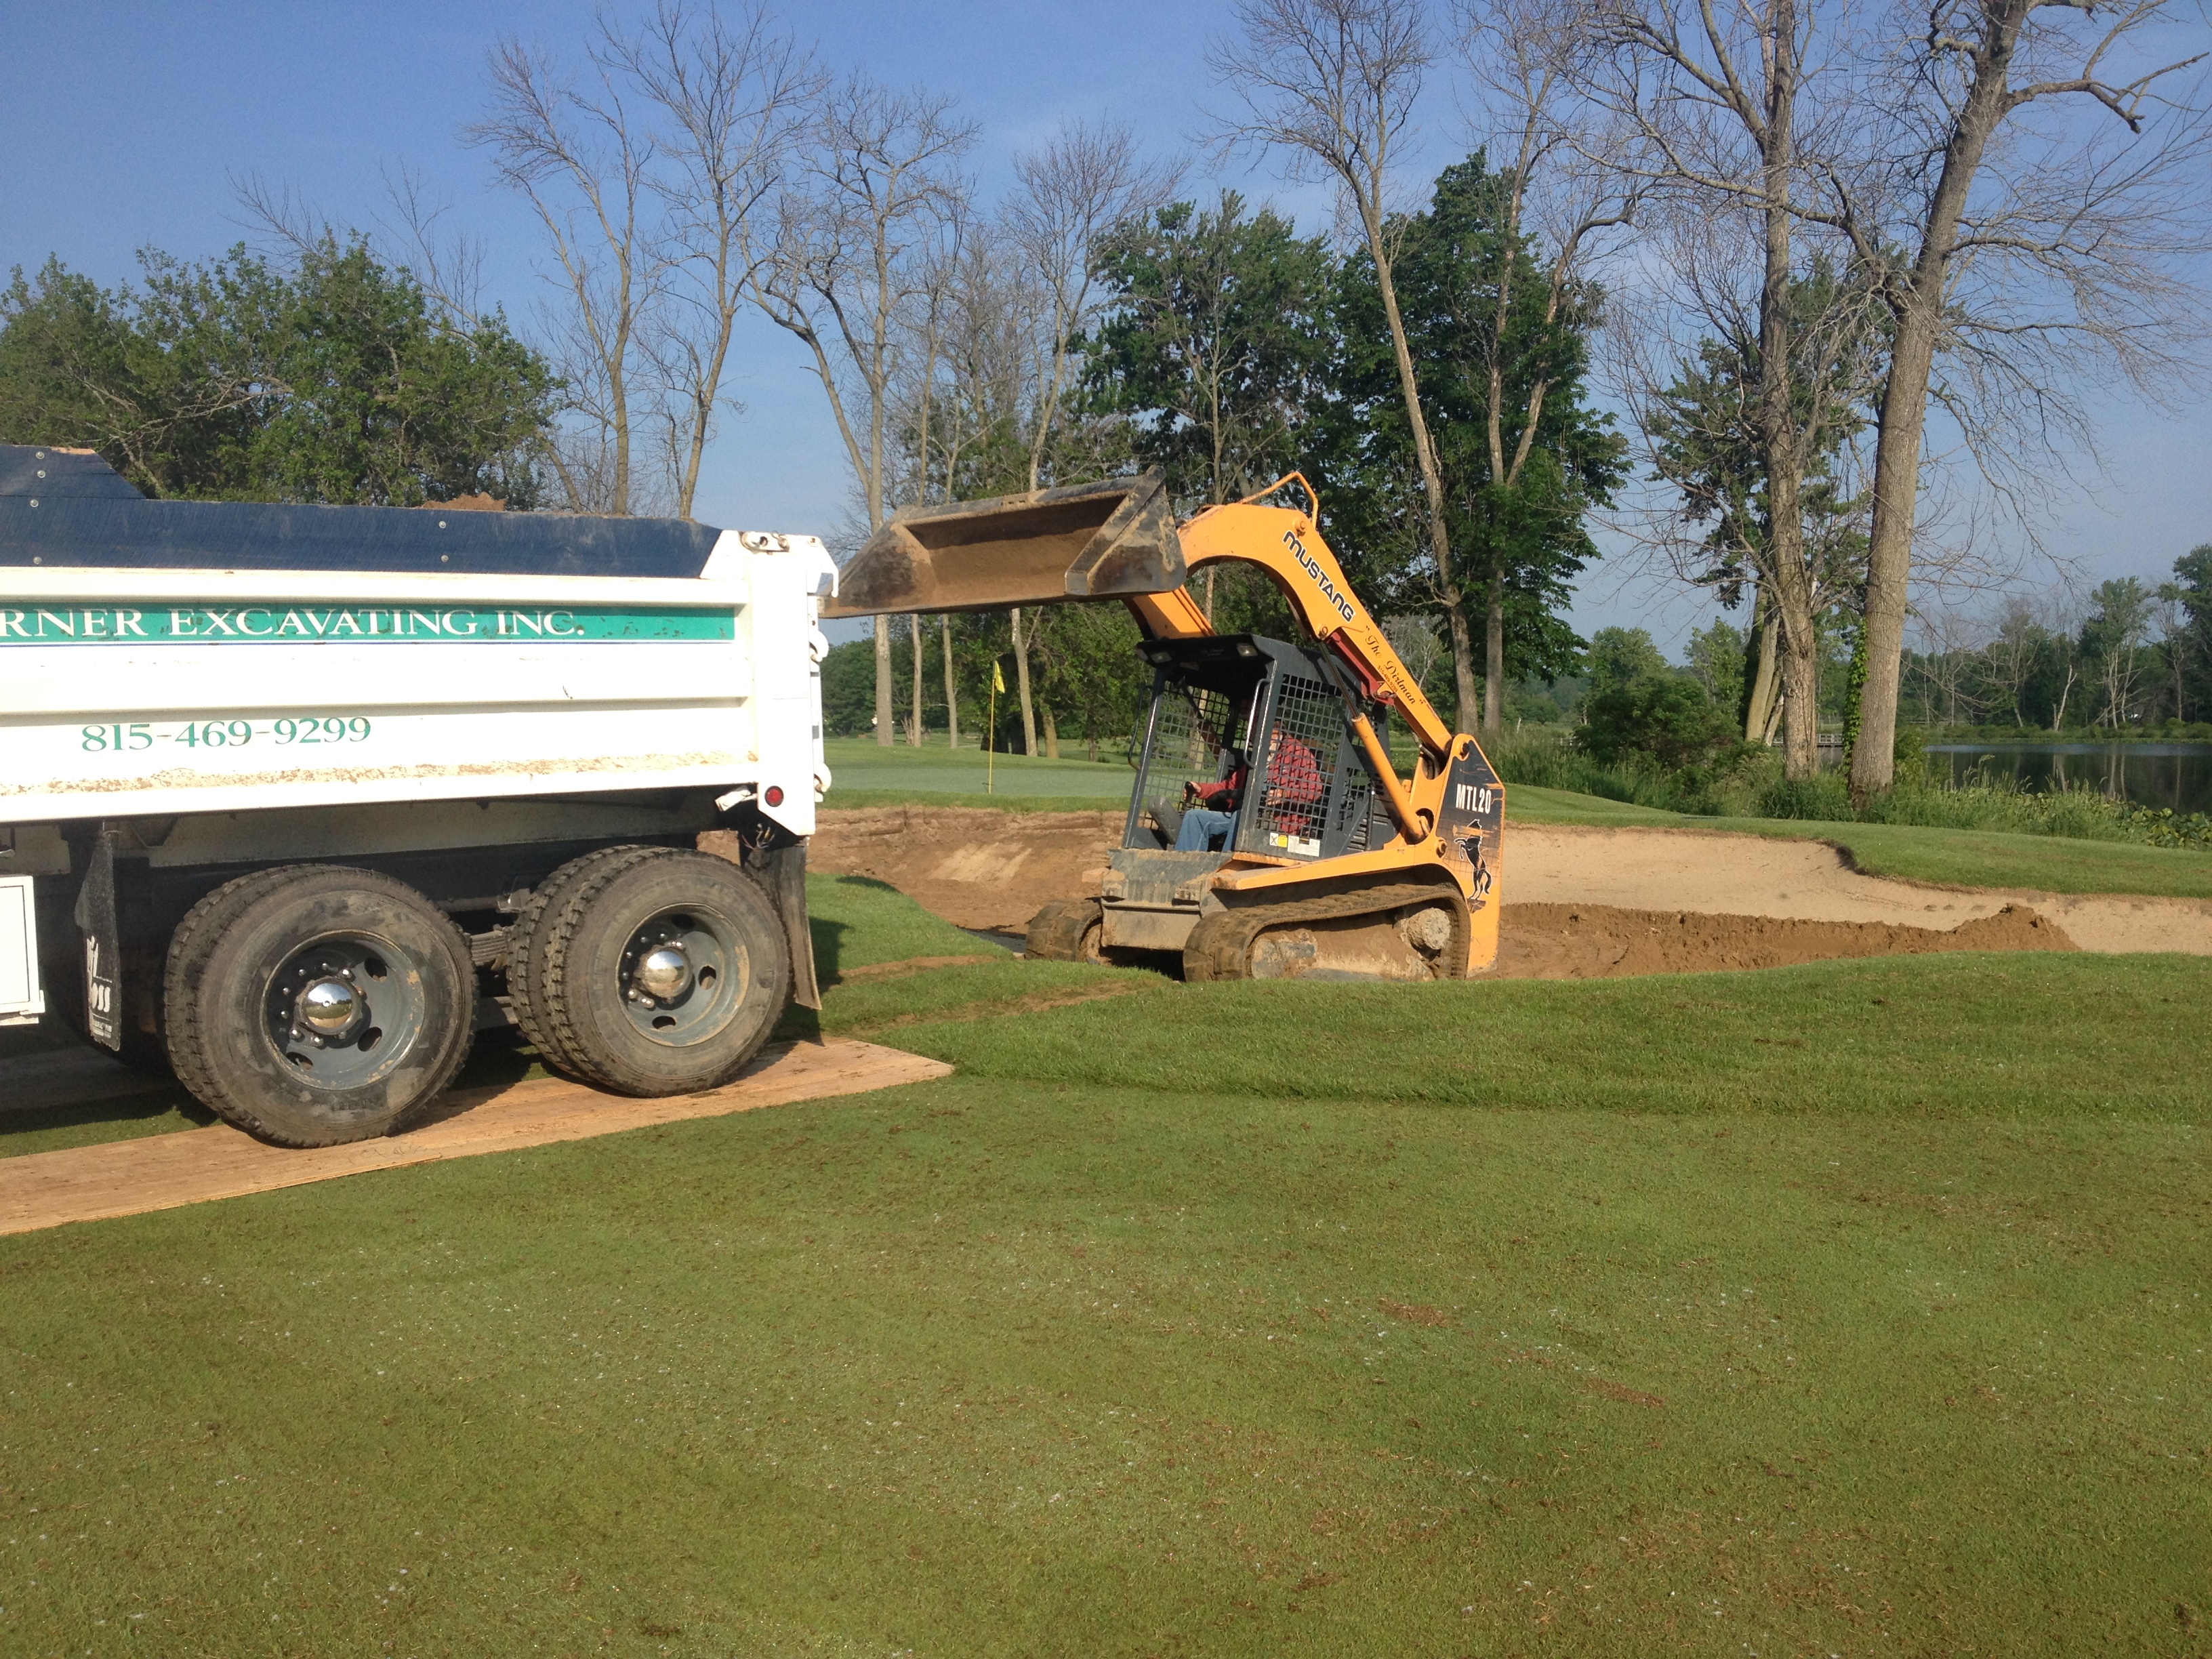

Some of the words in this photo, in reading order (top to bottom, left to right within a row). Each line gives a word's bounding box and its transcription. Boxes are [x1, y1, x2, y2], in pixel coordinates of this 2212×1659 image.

[1282, 530, 1355, 623] MUSTANG
[0, 609, 148, 636] RNER
[167, 607, 478, 636] EXCAVATING
[495, 609, 585, 636] INC.
[81, 717, 371, 752] 815-469-9299
[1455, 783, 1492, 815] MTL20
